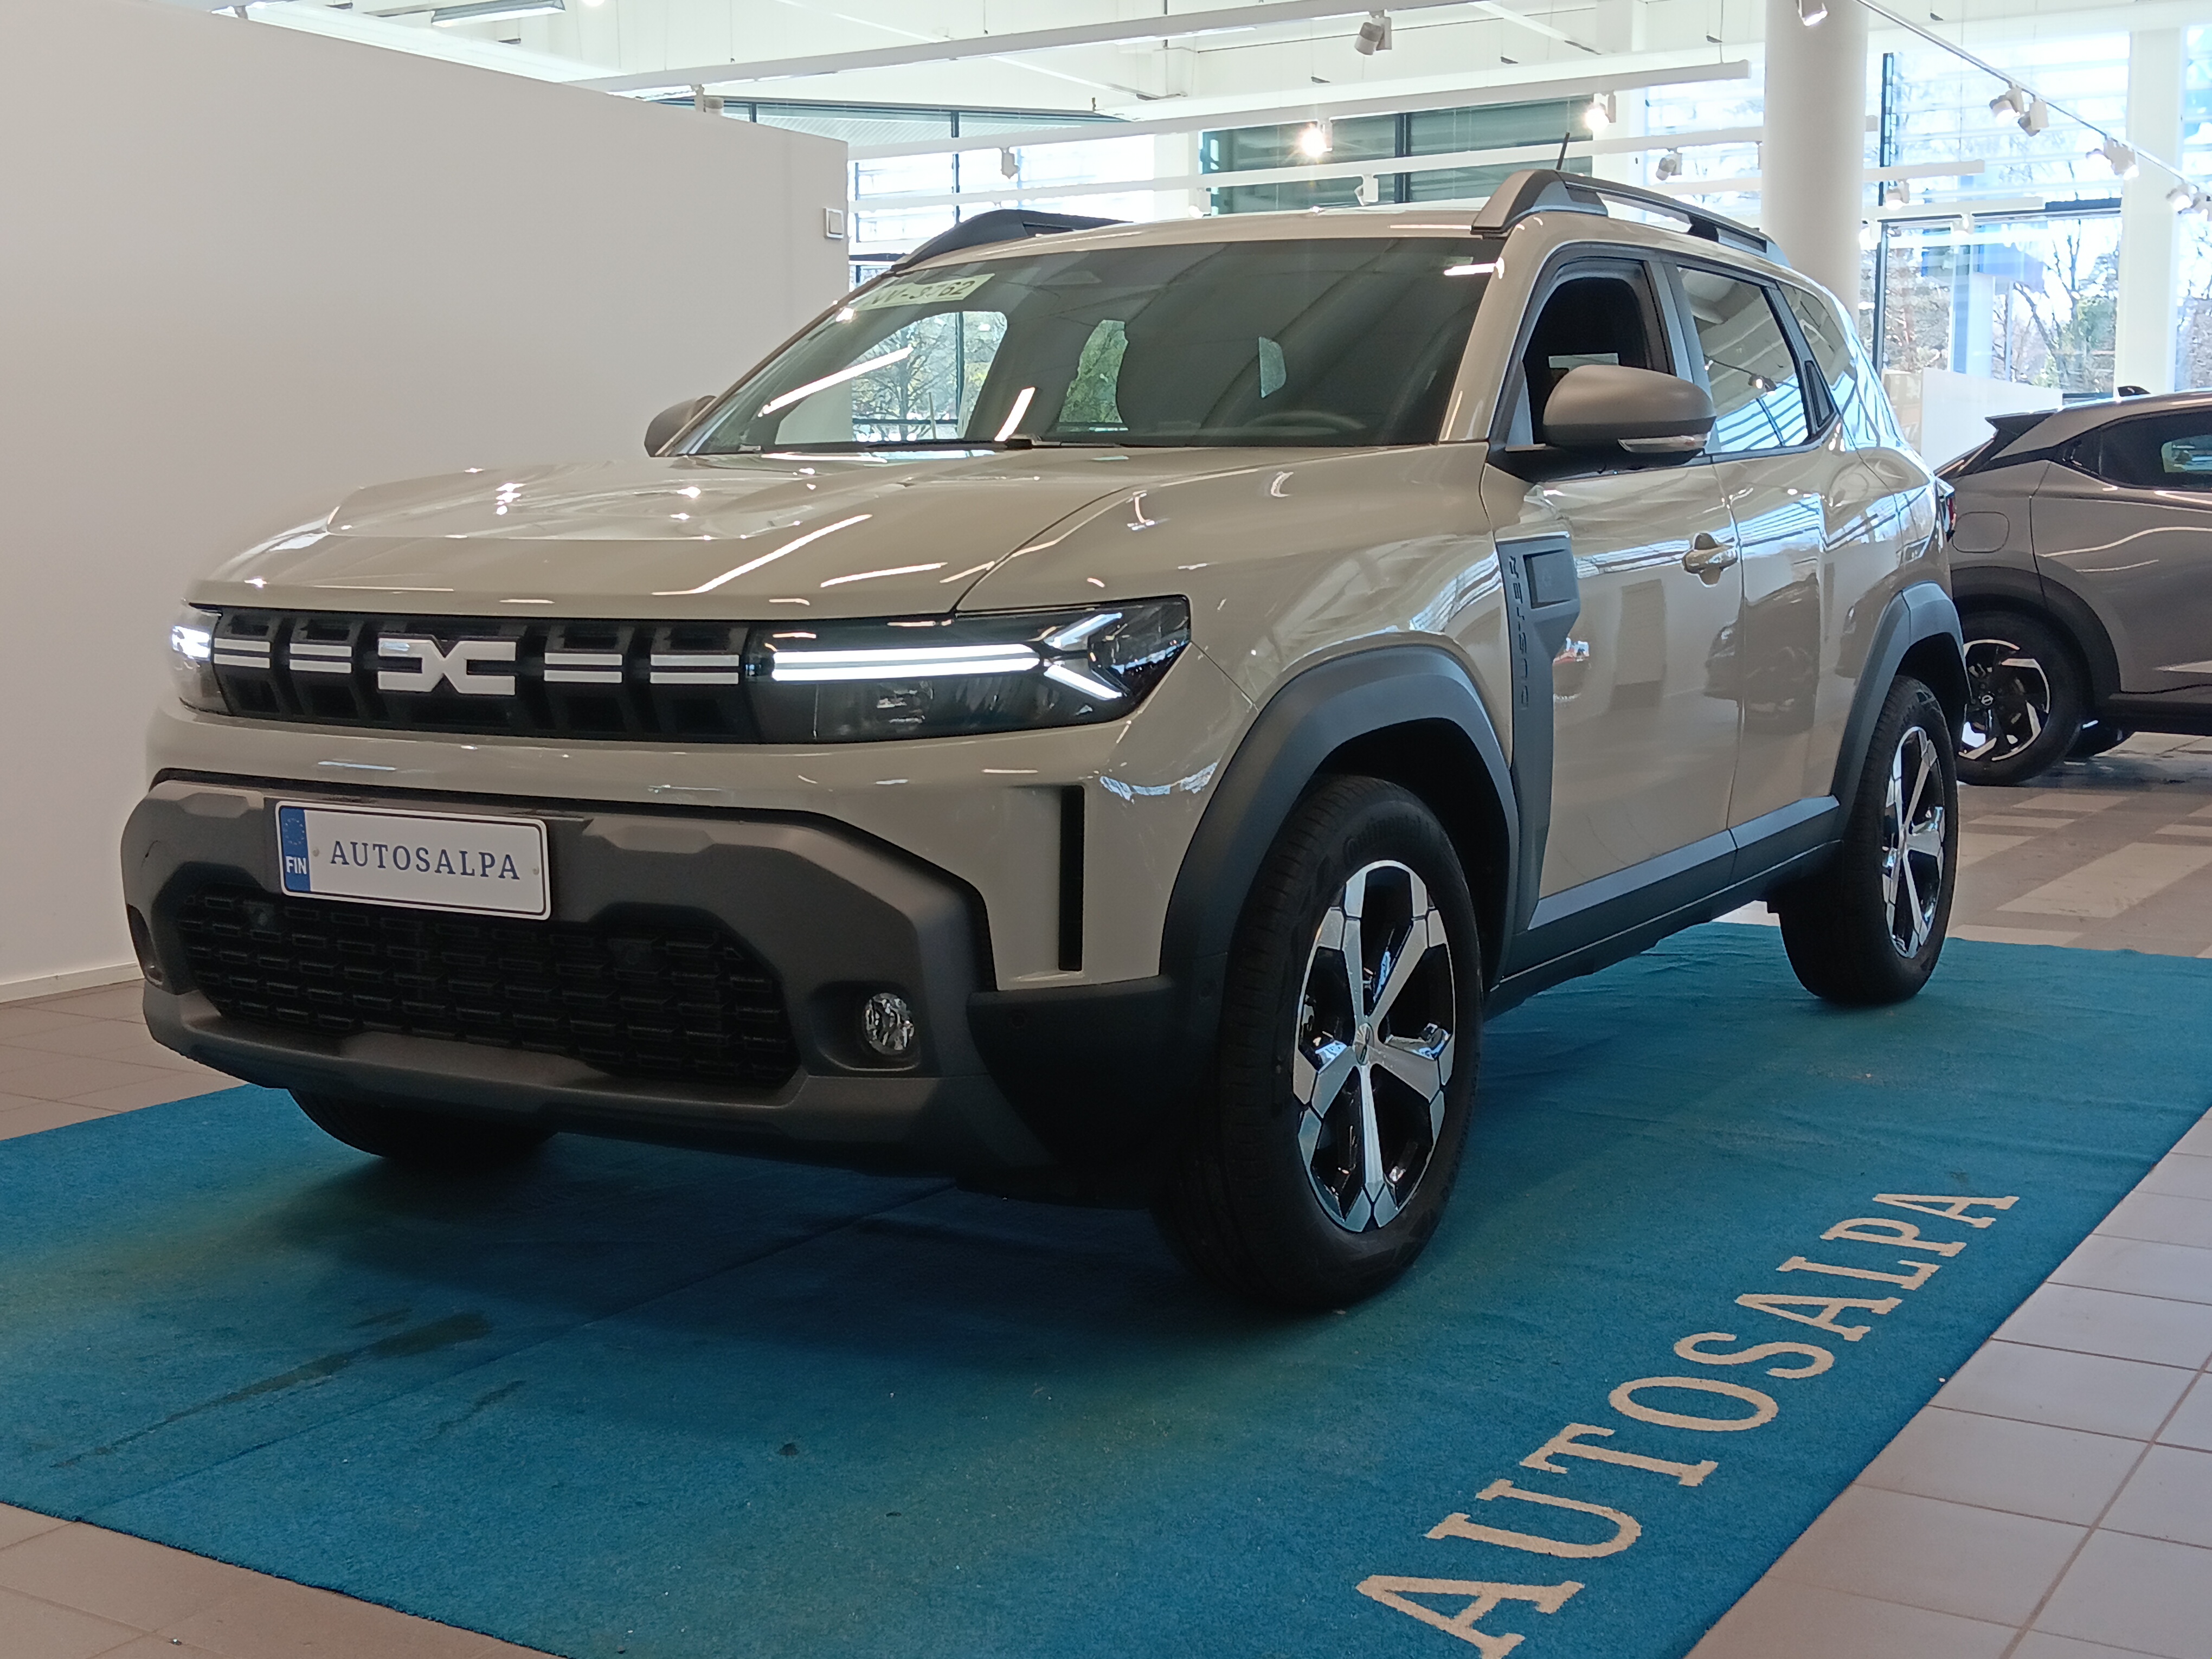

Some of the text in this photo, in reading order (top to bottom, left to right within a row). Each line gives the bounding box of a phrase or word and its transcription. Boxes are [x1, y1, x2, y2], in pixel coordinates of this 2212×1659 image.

[285, 856, 307, 875] FIN
[330, 841, 520, 880] AUTOSALPA
[1355, 1193, 2020, 1659] AUTOSALPA
